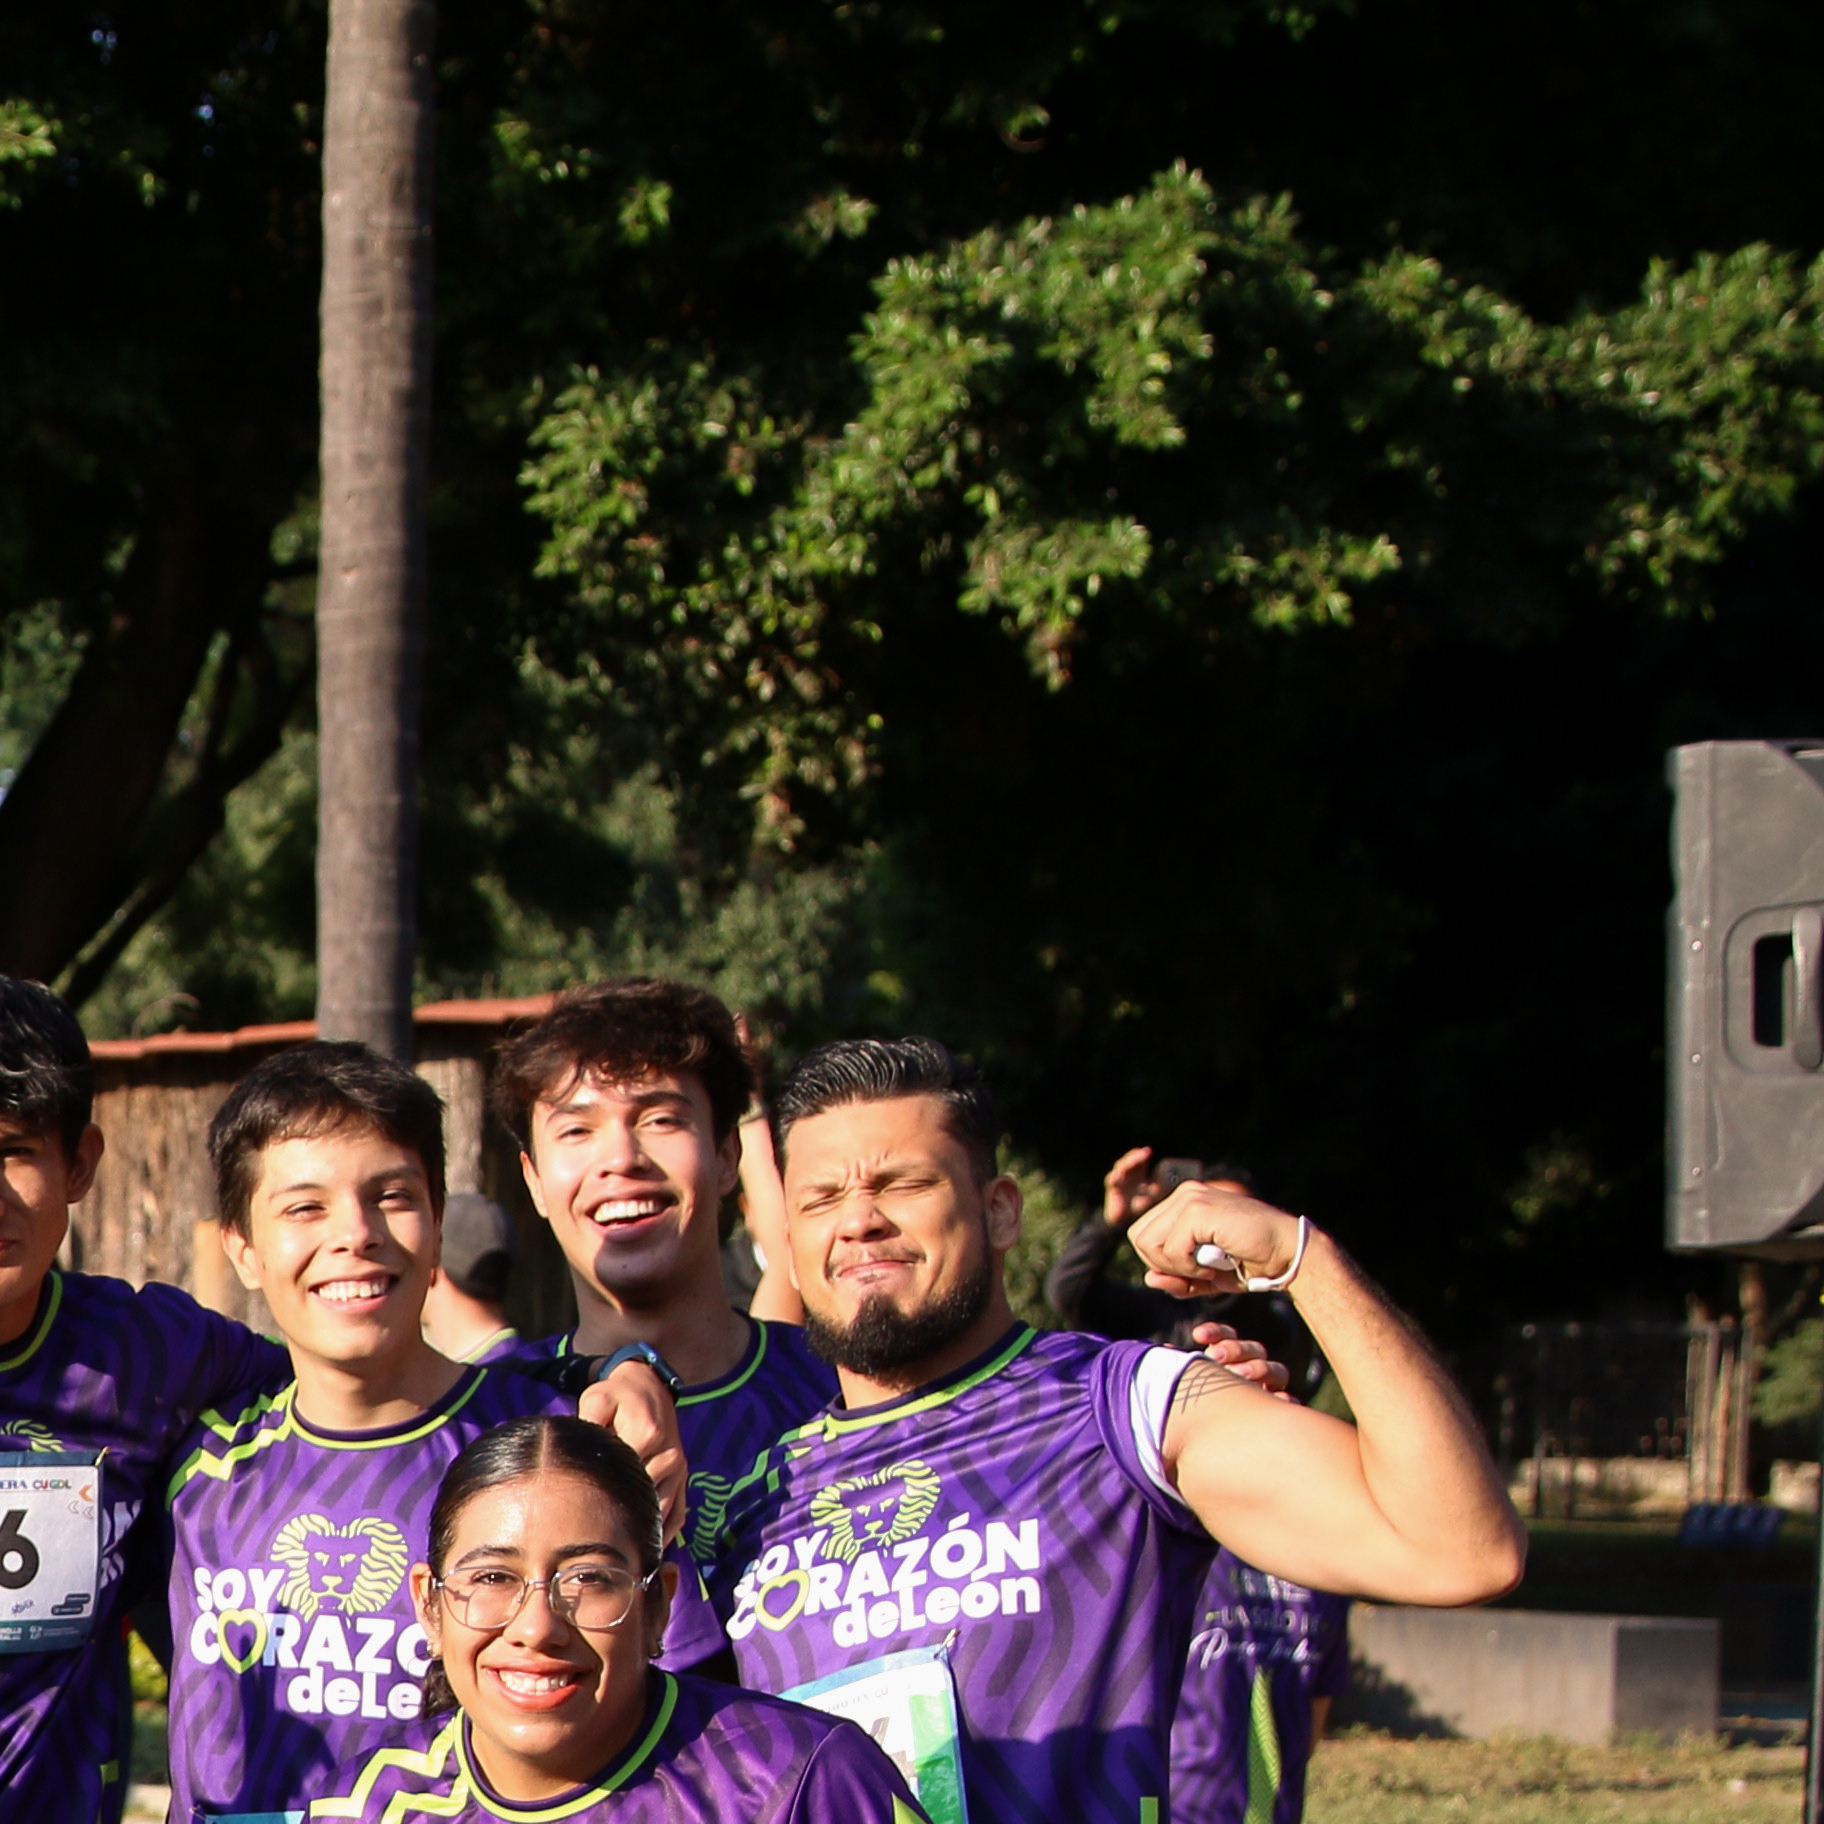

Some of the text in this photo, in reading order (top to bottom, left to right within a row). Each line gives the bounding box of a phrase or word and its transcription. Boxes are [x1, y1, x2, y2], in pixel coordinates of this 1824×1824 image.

[33, 1477, 72, 1490] CUGDL
[193, 1566, 286, 1614] SOY
[732, 1528, 831, 1601] SOY
[189, 1608, 439, 1677] CORAZ
[287, 1668, 423, 1721] deLe
